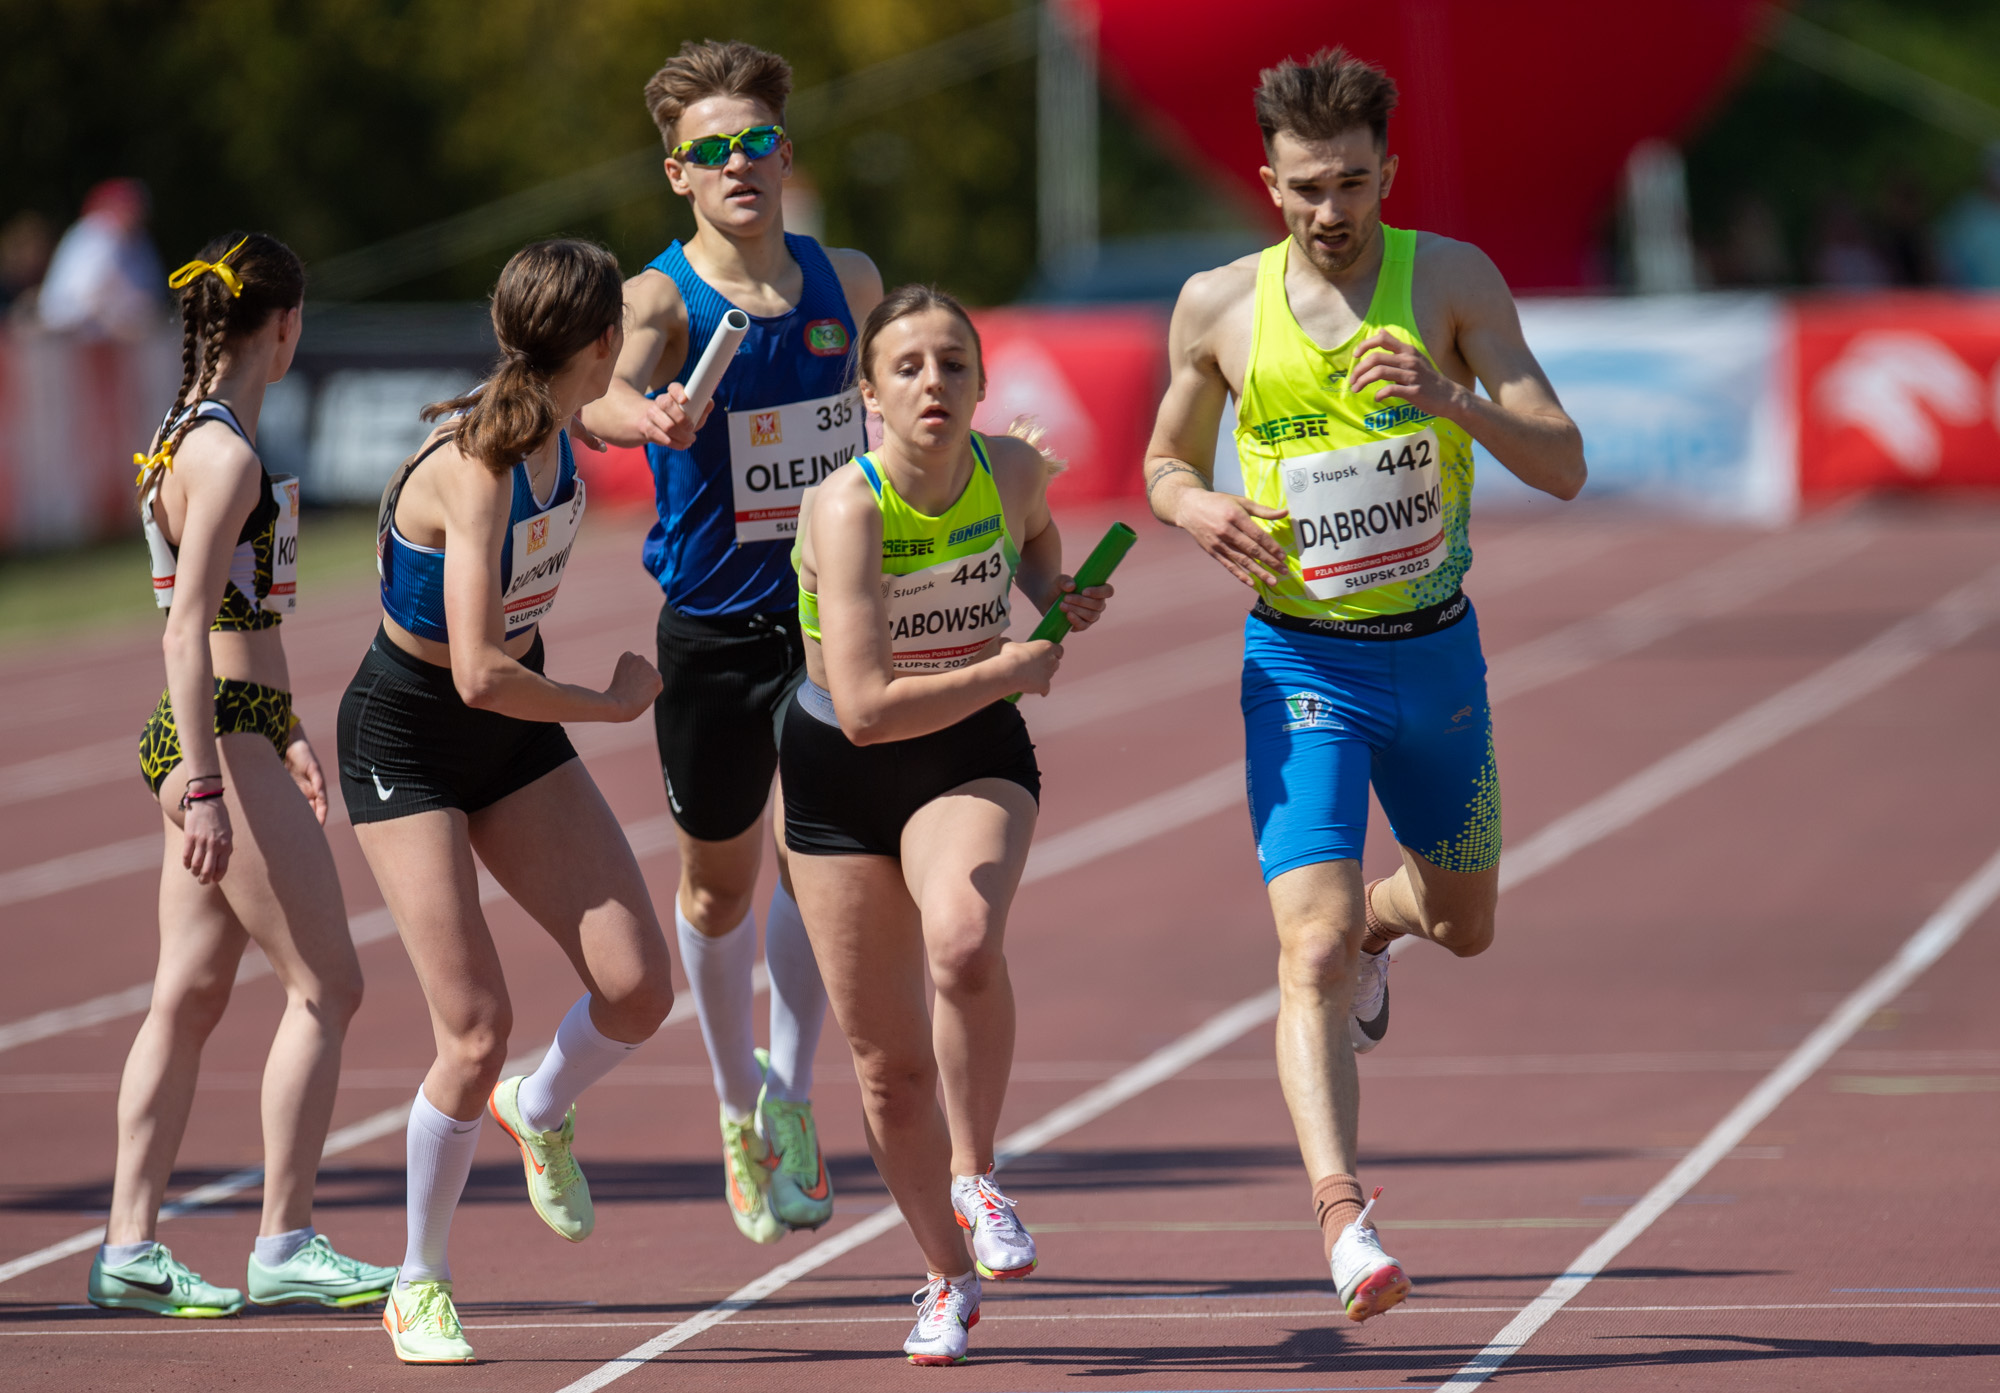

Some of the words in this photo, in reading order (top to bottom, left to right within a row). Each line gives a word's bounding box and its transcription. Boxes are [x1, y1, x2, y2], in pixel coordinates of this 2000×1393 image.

[816, 398, 852, 431] 335
[1376, 440, 1432, 475] 442
[1312, 466, 1359, 483] Słupsk
[776, 521, 798, 532] SŁU
[1299, 483, 1441, 550] DĄBROWSKI
[951, 552, 1001, 585] 443
[1314, 568, 1334, 577] PZLA
[1334, 556, 1382, 573] Mistrzostwa
[1382, 551, 1405, 564] Polski
[1405, 550, 1414, 558] w
[1345, 569, 1396, 588] SŁUPSK
[1399, 558, 1430, 576] 2023
[893, 581, 935, 598] Słupsk
[509, 604, 545, 625] SŁUPSK
[889, 594, 1007, 641] ABOWSKA
[931, 651, 954, 659] Polski
